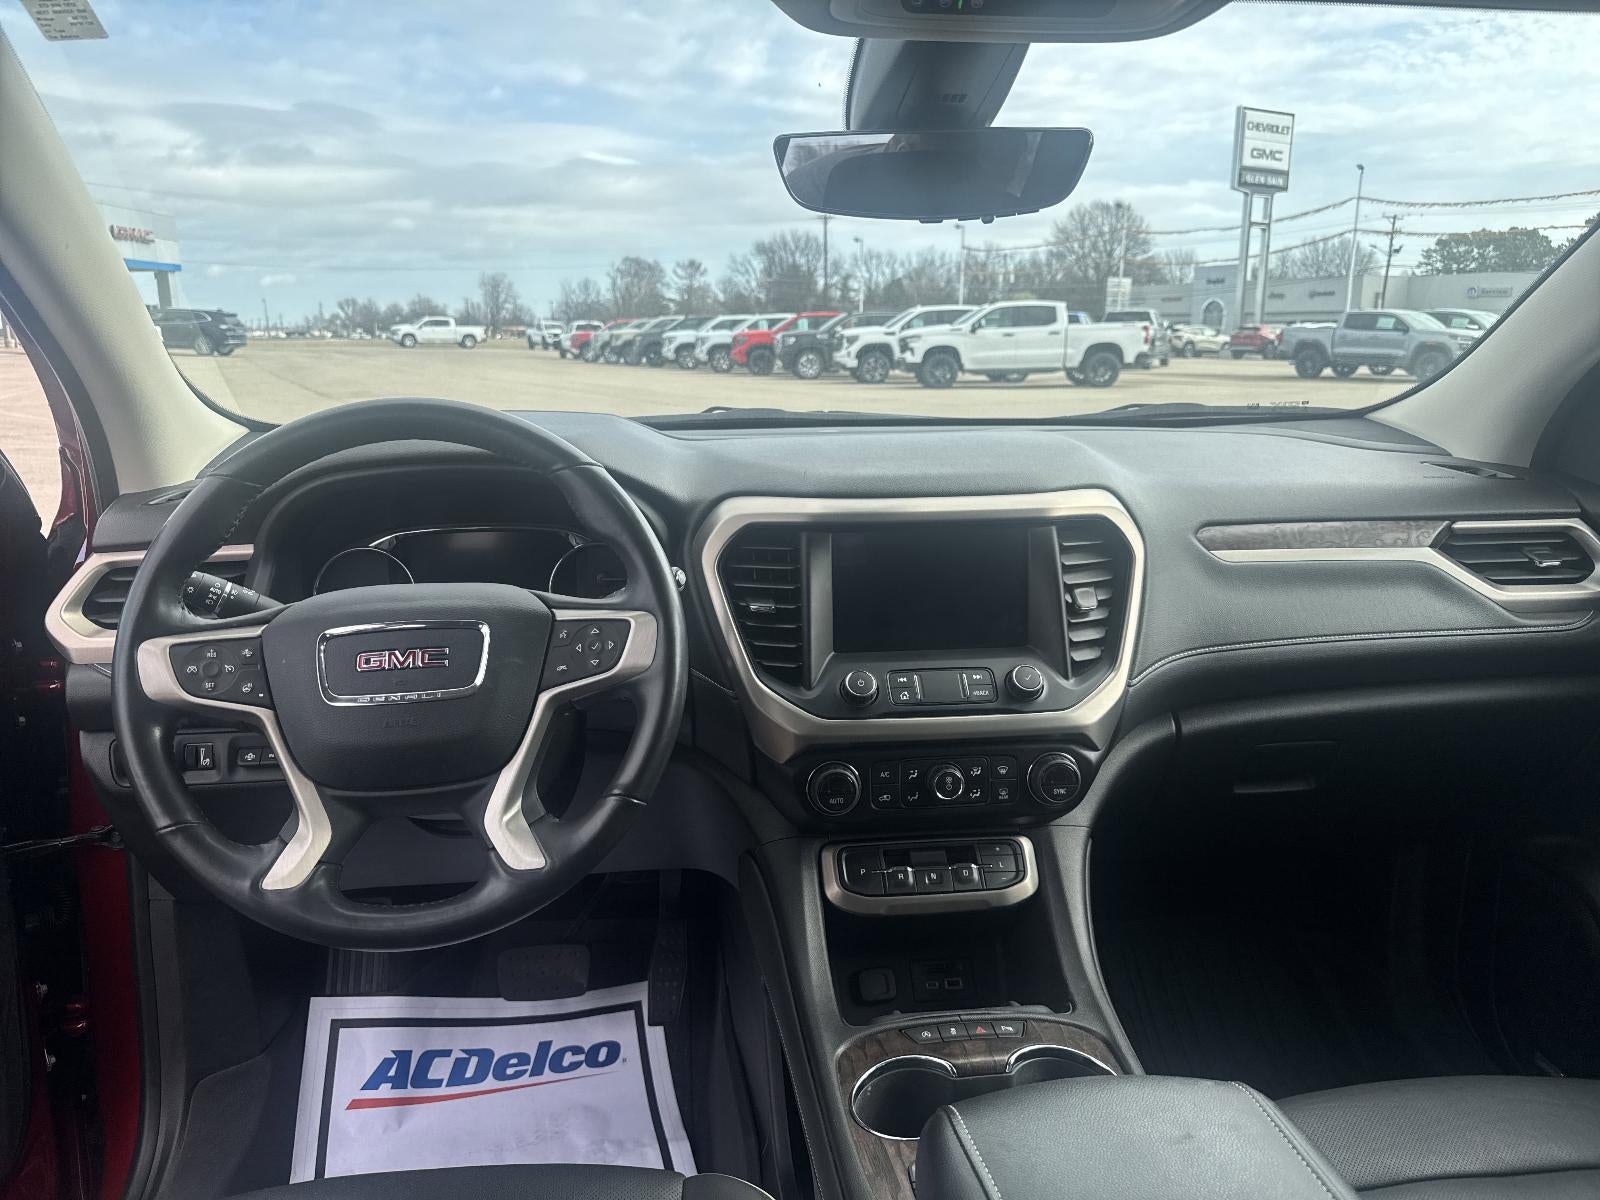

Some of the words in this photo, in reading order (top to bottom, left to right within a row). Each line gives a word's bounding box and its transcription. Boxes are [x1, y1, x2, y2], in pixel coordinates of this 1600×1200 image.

[1247, 121, 1290, 135] CHEVROLET
[1250, 147, 1283, 161] GMC
[357, 648, 449, 671] GMC
[860, 868, 866, 876] P
[930, 872, 937, 880] N
[962, 869, 969, 877] D
[360, 1040, 621, 1091] ACDelco
